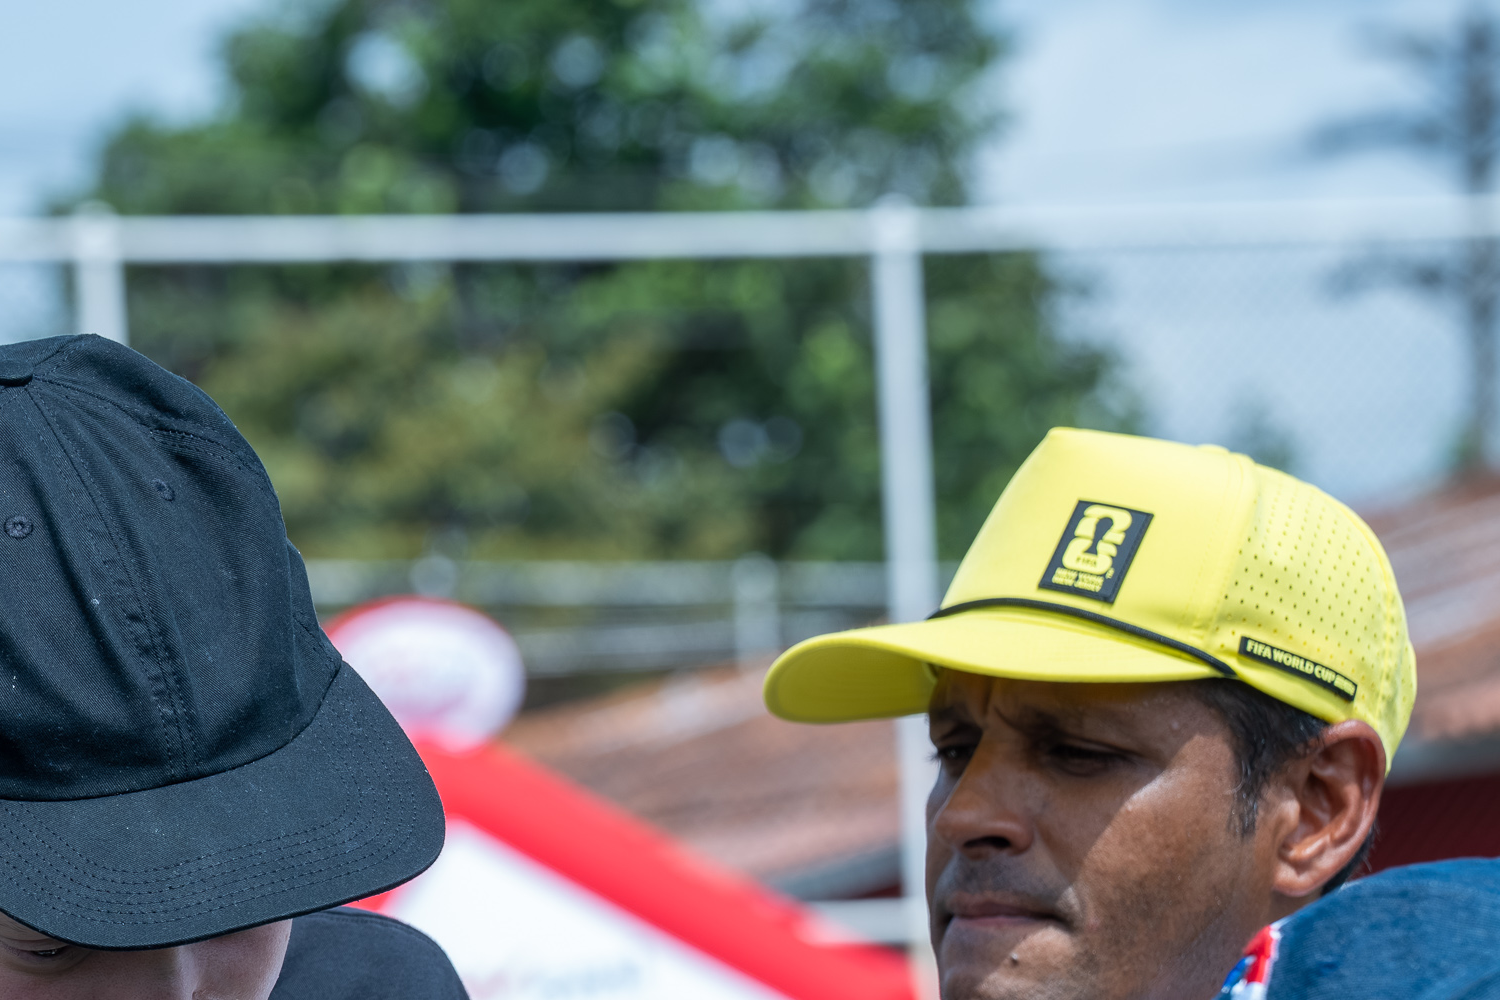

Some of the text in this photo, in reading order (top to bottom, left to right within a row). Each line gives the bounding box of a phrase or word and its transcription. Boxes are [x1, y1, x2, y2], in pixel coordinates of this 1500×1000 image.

[1246, 639, 1336, 684] FIFA WORLD CUP
